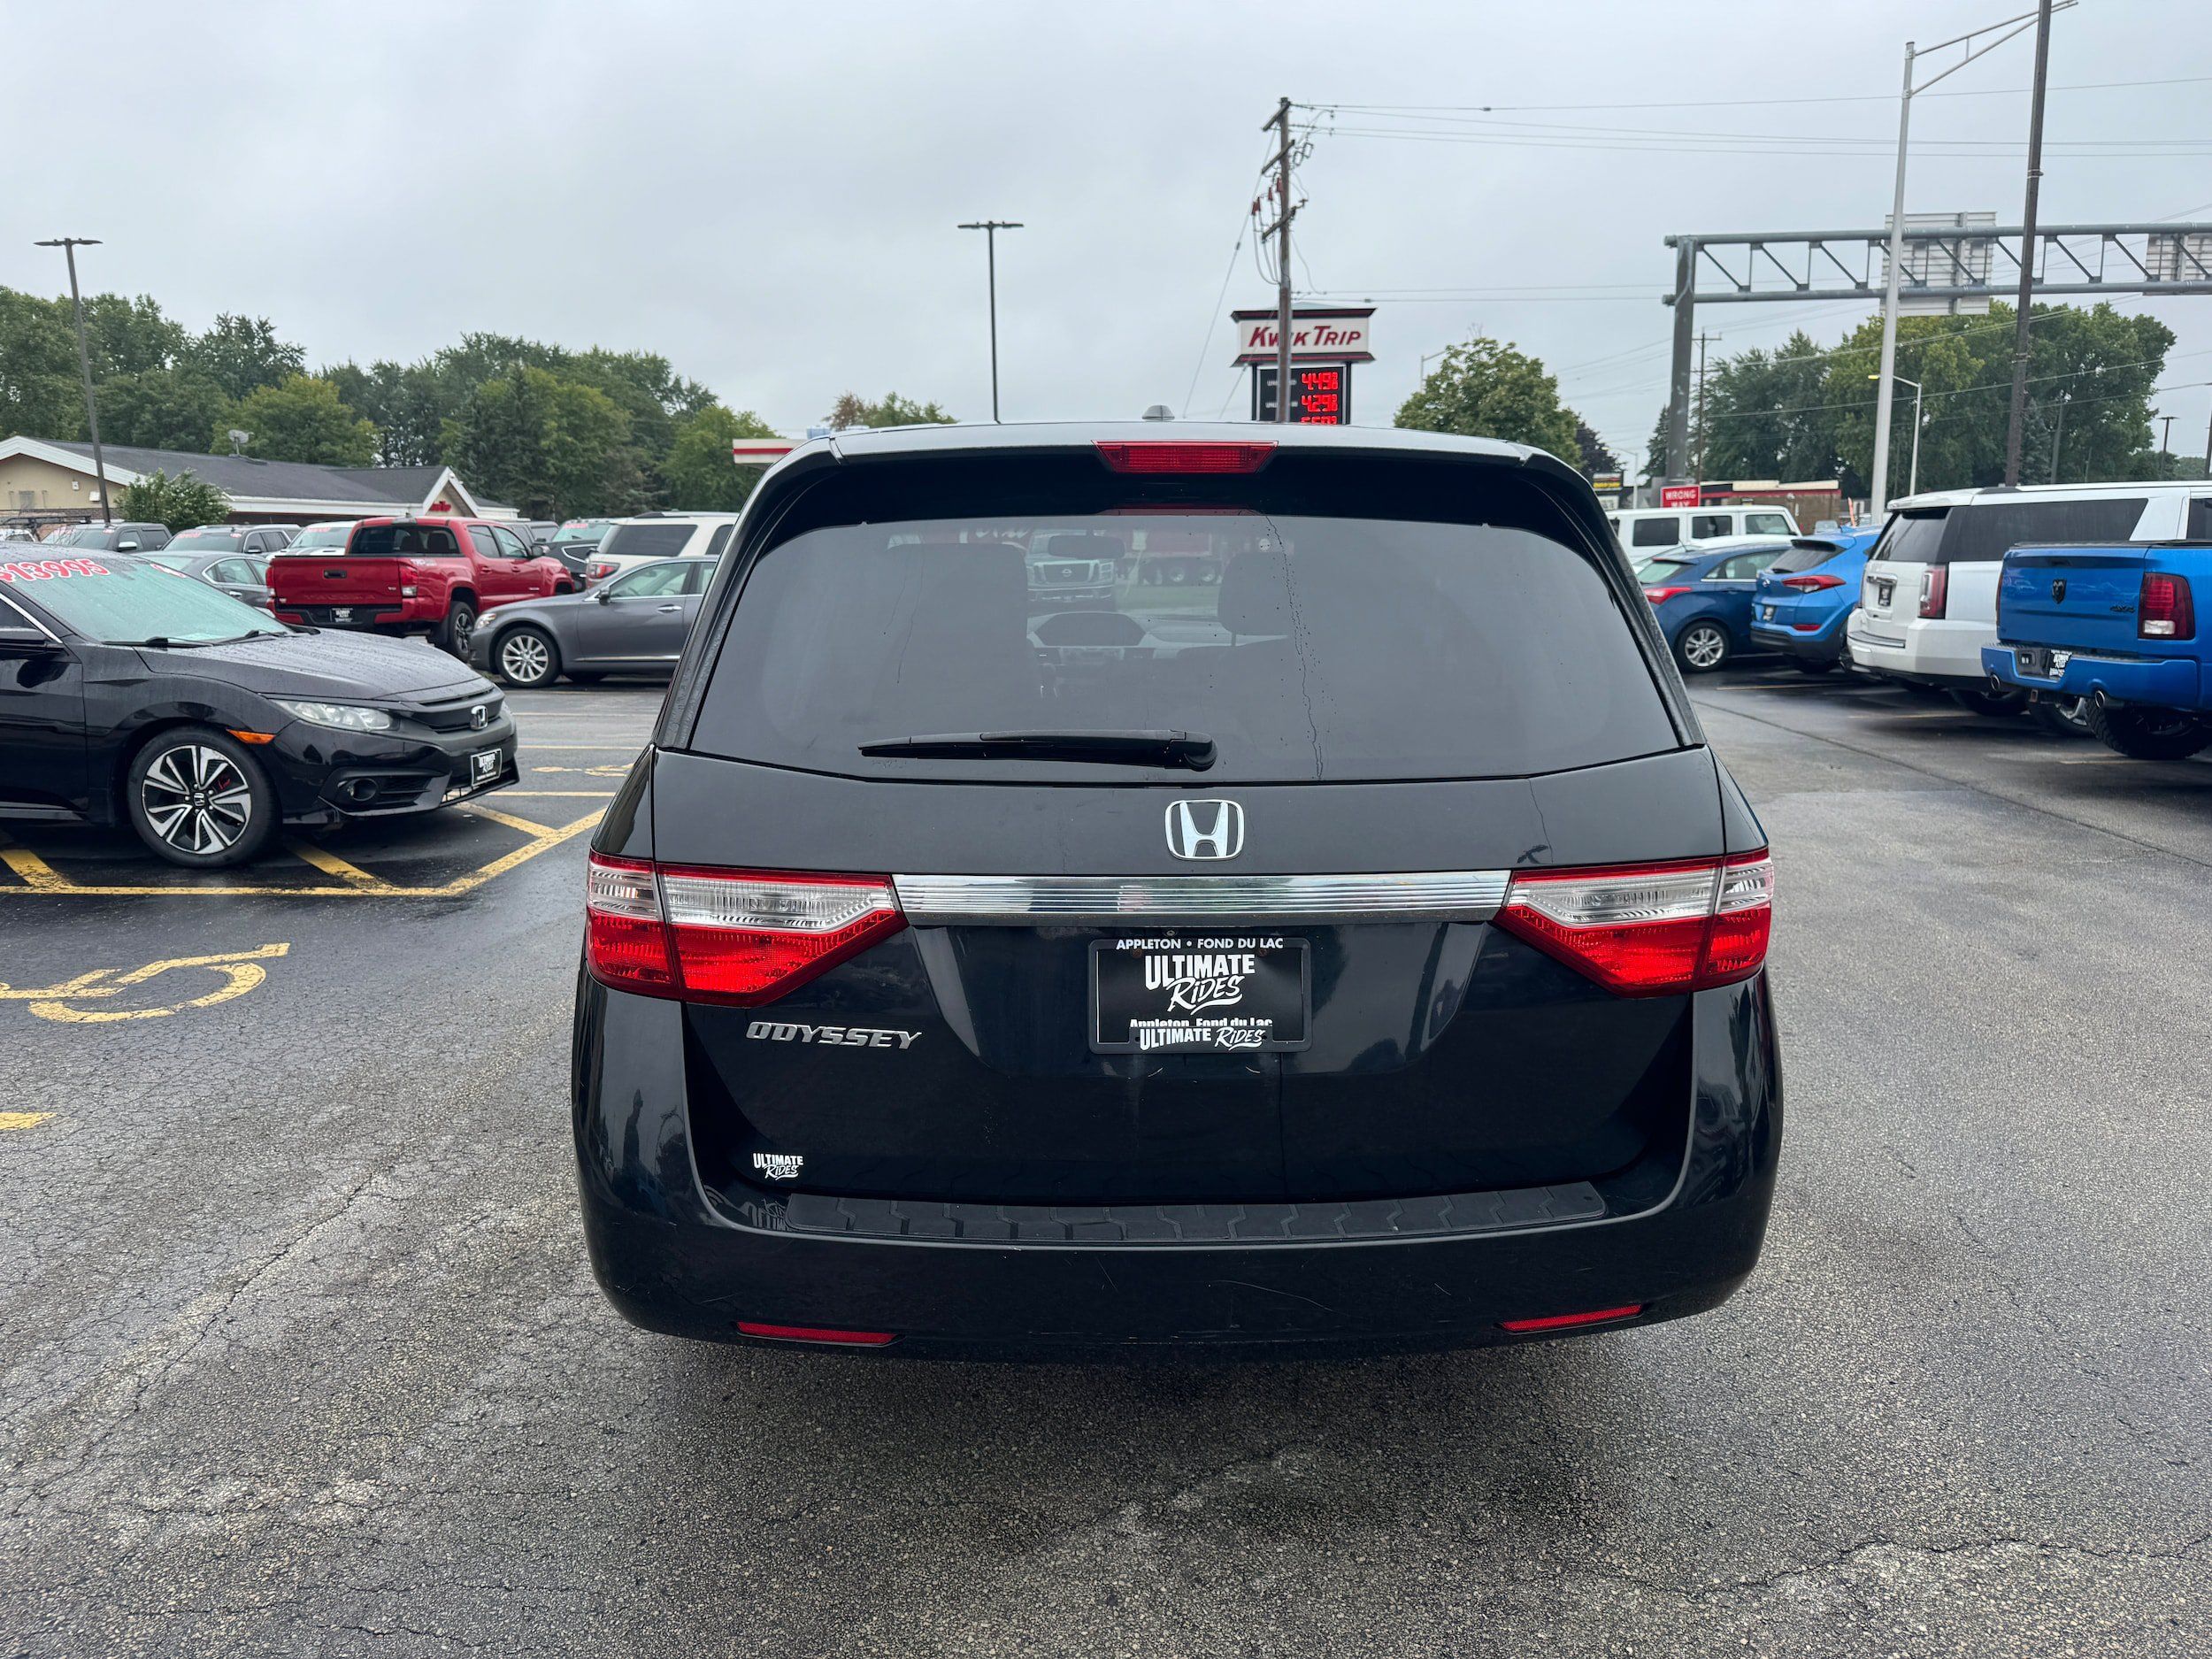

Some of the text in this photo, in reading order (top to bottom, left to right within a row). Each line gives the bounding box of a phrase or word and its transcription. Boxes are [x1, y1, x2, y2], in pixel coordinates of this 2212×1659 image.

[1248, 325, 1362, 347] KWK TRIP
[1665, 488, 1696, 500] WRONG
[1116, 938, 1284, 950] APPLETON FOND DU LAC
[1145, 954, 1256, 991] ULTIMATE
[746, 1021, 922, 1049] ODYSSEY
[1140, 1028, 1212, 1050] ULTIMATE
[753, 1153, 803, 1169] ULTIMATE
